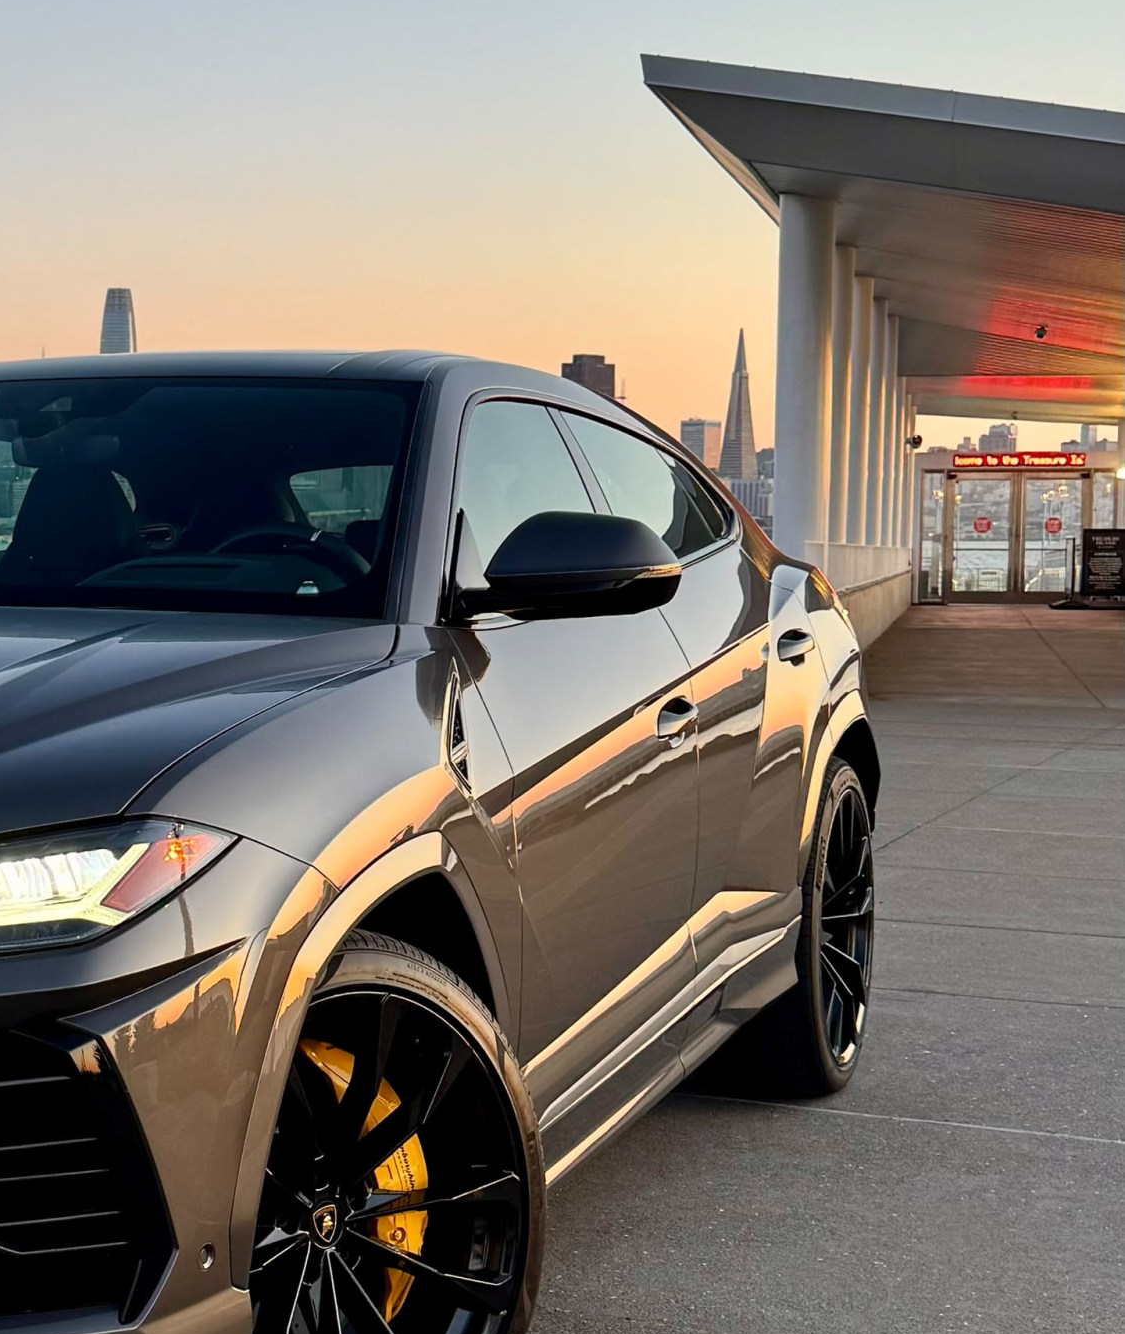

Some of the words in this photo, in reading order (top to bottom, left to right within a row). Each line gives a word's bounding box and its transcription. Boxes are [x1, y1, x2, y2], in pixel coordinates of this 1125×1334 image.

[986, 455, 998, 465] to
[1002, 455, 1019, 466] the
[1023, 455, 1067, 465] Treasure
